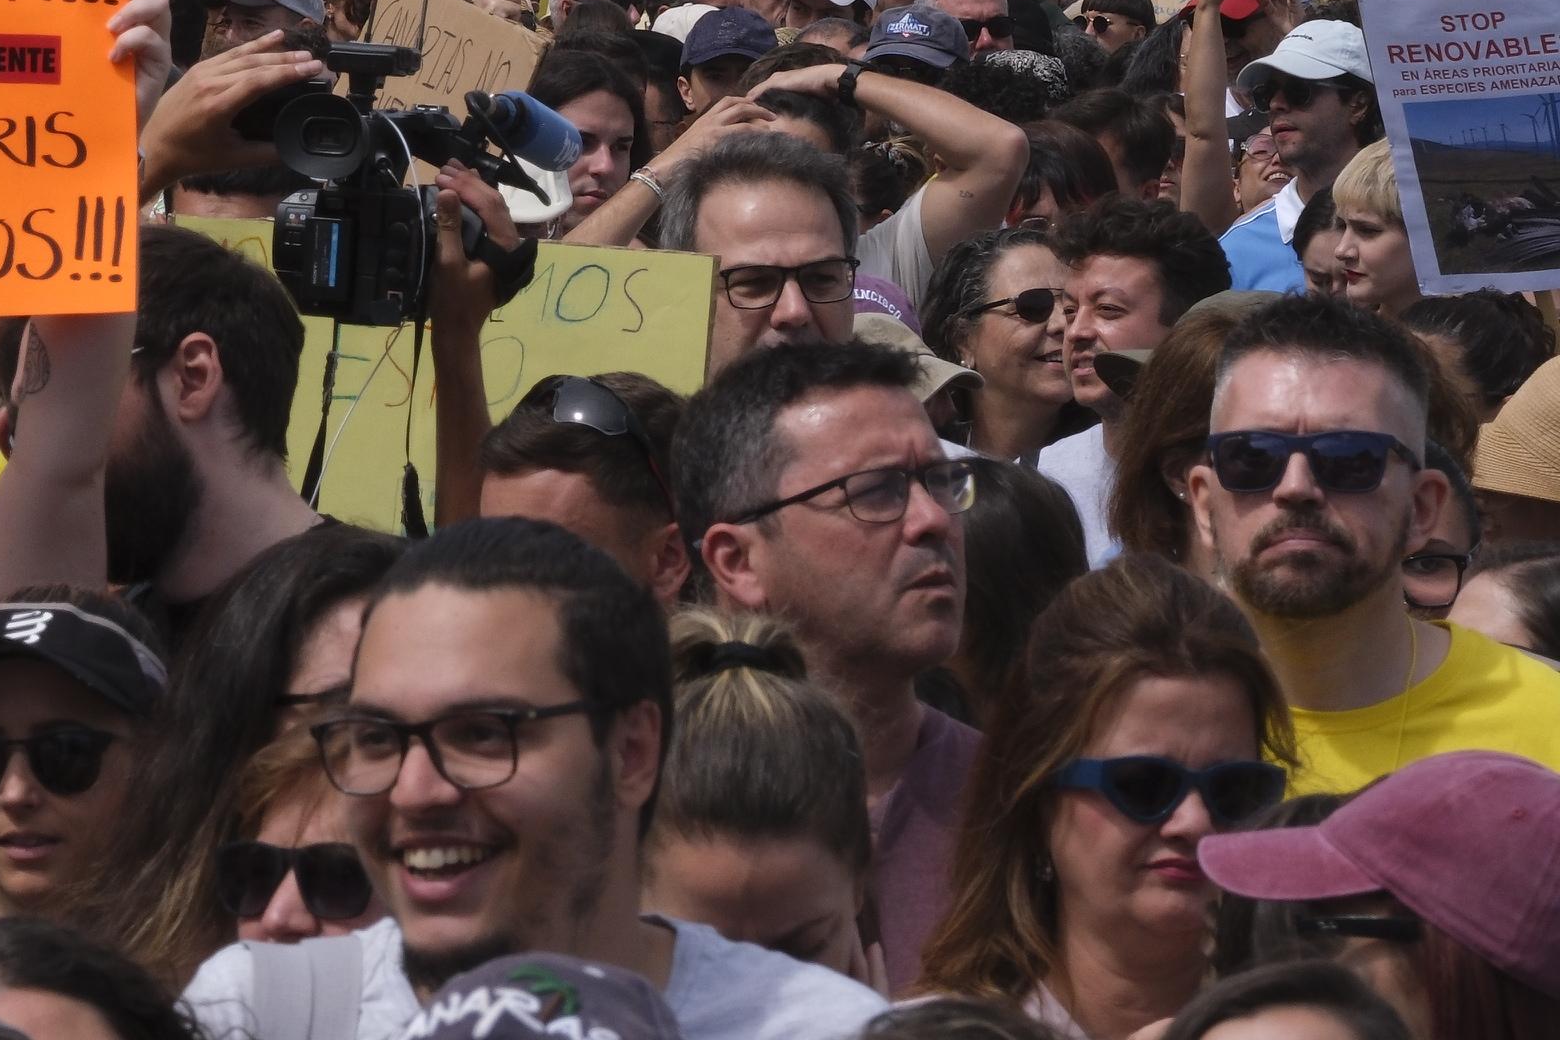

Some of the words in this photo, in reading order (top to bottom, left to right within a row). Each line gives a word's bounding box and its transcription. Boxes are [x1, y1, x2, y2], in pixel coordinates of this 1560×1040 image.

[888, 21, 929, 32] ZERMATT
[1440, 11, 1506, 33] STOP
[371, 0, 474, 96] CANRIAS
[1387, 33, 1560, 64] RENOVABLE
[1401, 70, 1420, 81] EN
[1424, 67, 1469, 81] ÁREAS
[1473, 61, 1560, 78] PRIORITARIA
[1392, 87, 1417, 99] para
[1420, 81, 1486, 96] ESPECIES
